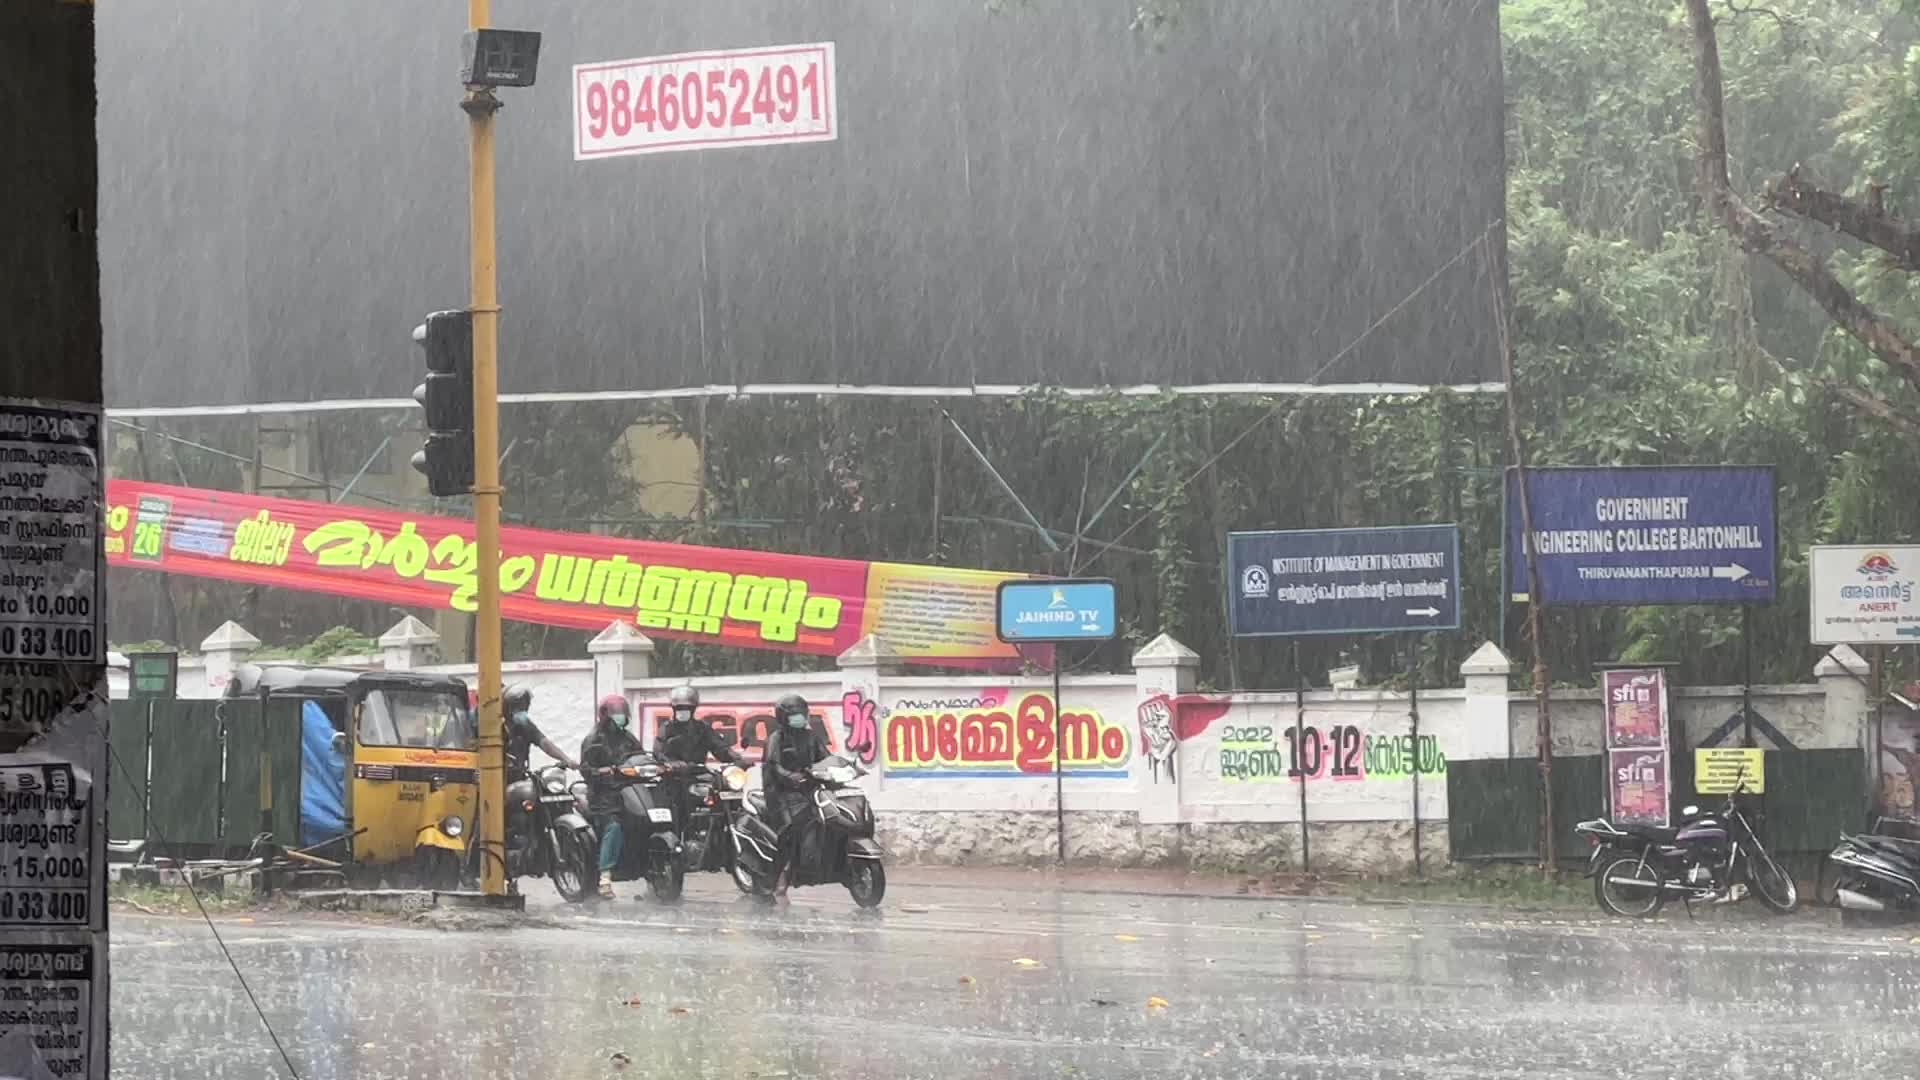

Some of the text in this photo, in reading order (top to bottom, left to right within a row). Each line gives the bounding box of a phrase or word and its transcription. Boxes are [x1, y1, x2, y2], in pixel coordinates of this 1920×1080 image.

[587, 62, 820, 139] 9846052491
[1596, 497, 1688, 522] GOVERNMENT
[134, 522, 161, 555] 26
[1523, 526, 1762, 554] NGINEERING COLLEGE BARTONHILL
[1272, 557, 1312, 574] INSTITUTE
[1325, 555, 1380, 572] MANAGEMENT
[1392, 552, 1444, 569] GOVERNMENT
[1578, 566, 1709, 579] THIRUVANANTHAPURAM
[26, 595, 89, 618] 10,000
[1016, 610, 1099, 624] JAIHIND TV
[1859, 602, 1897, 612] ANERT
[21, 627, 46, 656] 33
[1613, 684, 1634, 701] sfi
[1221, 725, 1273, 743] 2022
[1618, 764, 1640, 781] sfi
[14, 855, 84, 882] 15,000
[18, 892, 43, 920] 33
[48, 892, 86, 920] 400
